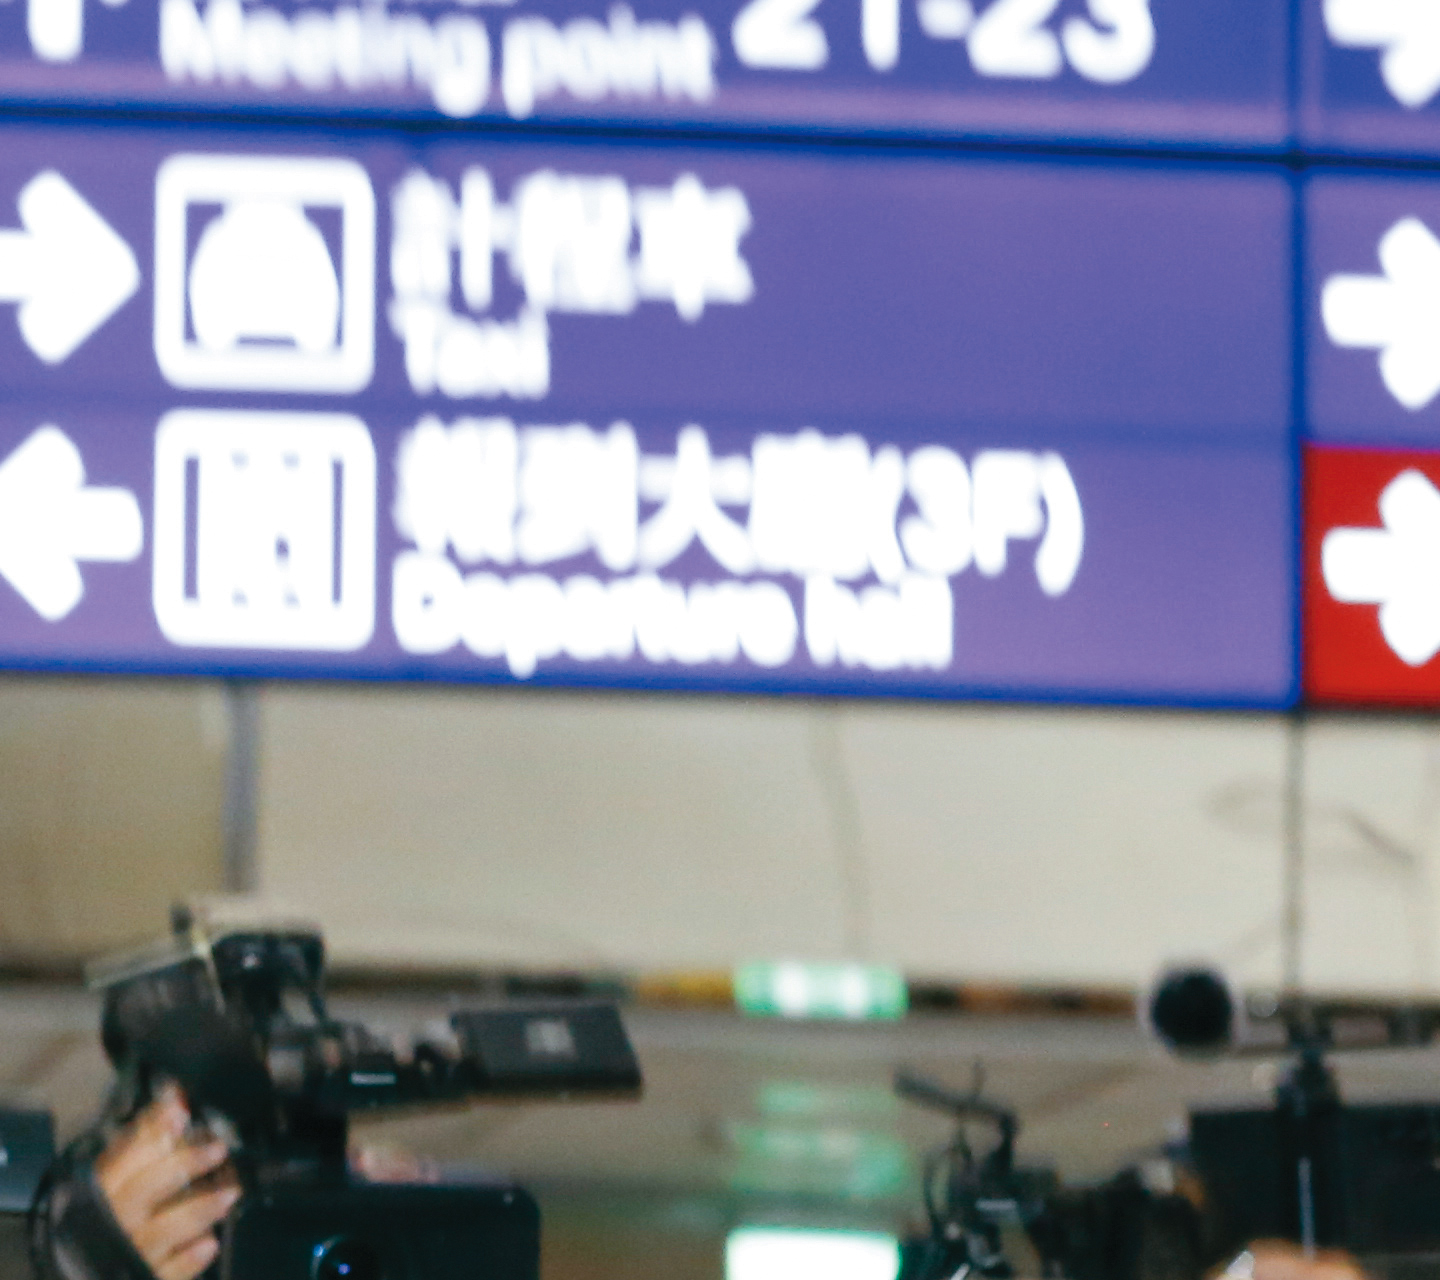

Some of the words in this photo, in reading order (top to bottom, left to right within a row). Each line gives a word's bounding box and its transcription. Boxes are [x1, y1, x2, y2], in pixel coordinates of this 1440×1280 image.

[158, 0, 490, 118] Meeting
[502, 6, 717, 119] point
[393, 168, 752, 320] 計程車
[390, 298, 549, 397] Taxi
[392, 551, 797, 676] Departure
[804, 572, 953, 670] hall
